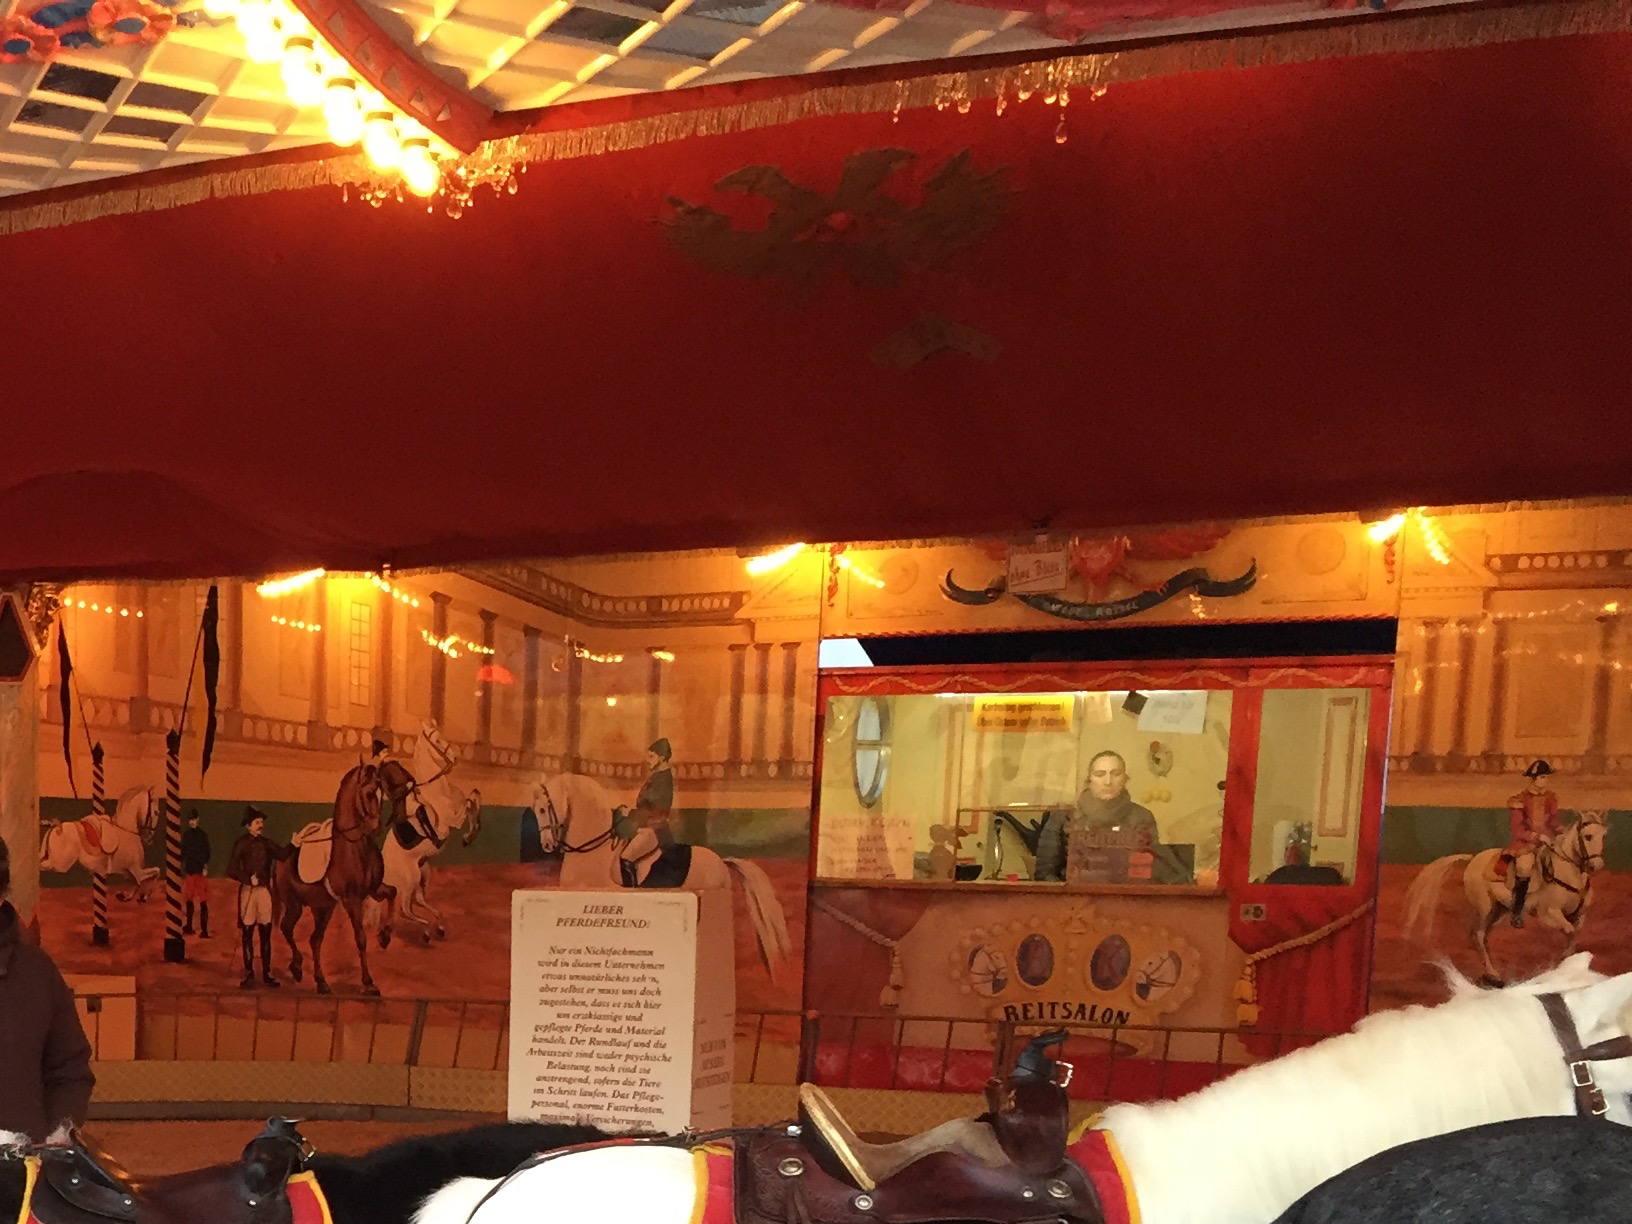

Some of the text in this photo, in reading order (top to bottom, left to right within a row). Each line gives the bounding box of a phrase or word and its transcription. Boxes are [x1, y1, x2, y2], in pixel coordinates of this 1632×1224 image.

[583, 905, 623, 915] LIEBER
[556, 918, 650, 929] PFERDEFREUND!
[549, 946, 566, 955] Nur
[584, 946, 653, 957] Nichtfachmann
[538, 959, 664, 970] wird in diesem Unternehmen
[539, 985, 558, 993] aber
[560, 985, 584, 993] selbst
[639, 988, 662, 996] doch
[539, 998, 589, 1008] zugestehen,
[590, 999, 610, 1008] dass
[623, 999, 640, 1009] sich
[644, 1000, 662, 1009] hier
[572, 1013, 623, 1022] erstklassige
[626, 1014, 643, 1022] und
[1003, 1001, 1131, 1025] REITSALON
[534, 1023, 572, 1033] gepflegte
[575, 1024, 602, 1034] Pferde
[625, 1026, 665, 1035] Material
[570, 1037, 585, 1045] Der
[588, 1038, 632, 1049] Rundlauf
[634, 1040, 650, 1048] und
[526, 1048, 573, 1057] Arbeitszeit
[596, 1052, 622, 1060] weder
[624, 1053, 672, 1062] psychische
[594, 1064, 615, 1072] noch
[618, 1065, 637, 1073] sind
[536, 1075, 590, 1084] anstrengend,
[594, 1078, 620, 1086] sofern
[639, 1079, 661, 1088] Tiere
[546, 1087, 577, 1096] Schritt
[579, 1088, 607, 1099] laufen.
[612, 1090, 629, 1099] Das
[632, 1091, 664, 1102] Pflege-
[531, 1100, 664, 1115] personal, enorme Futterkosten,
